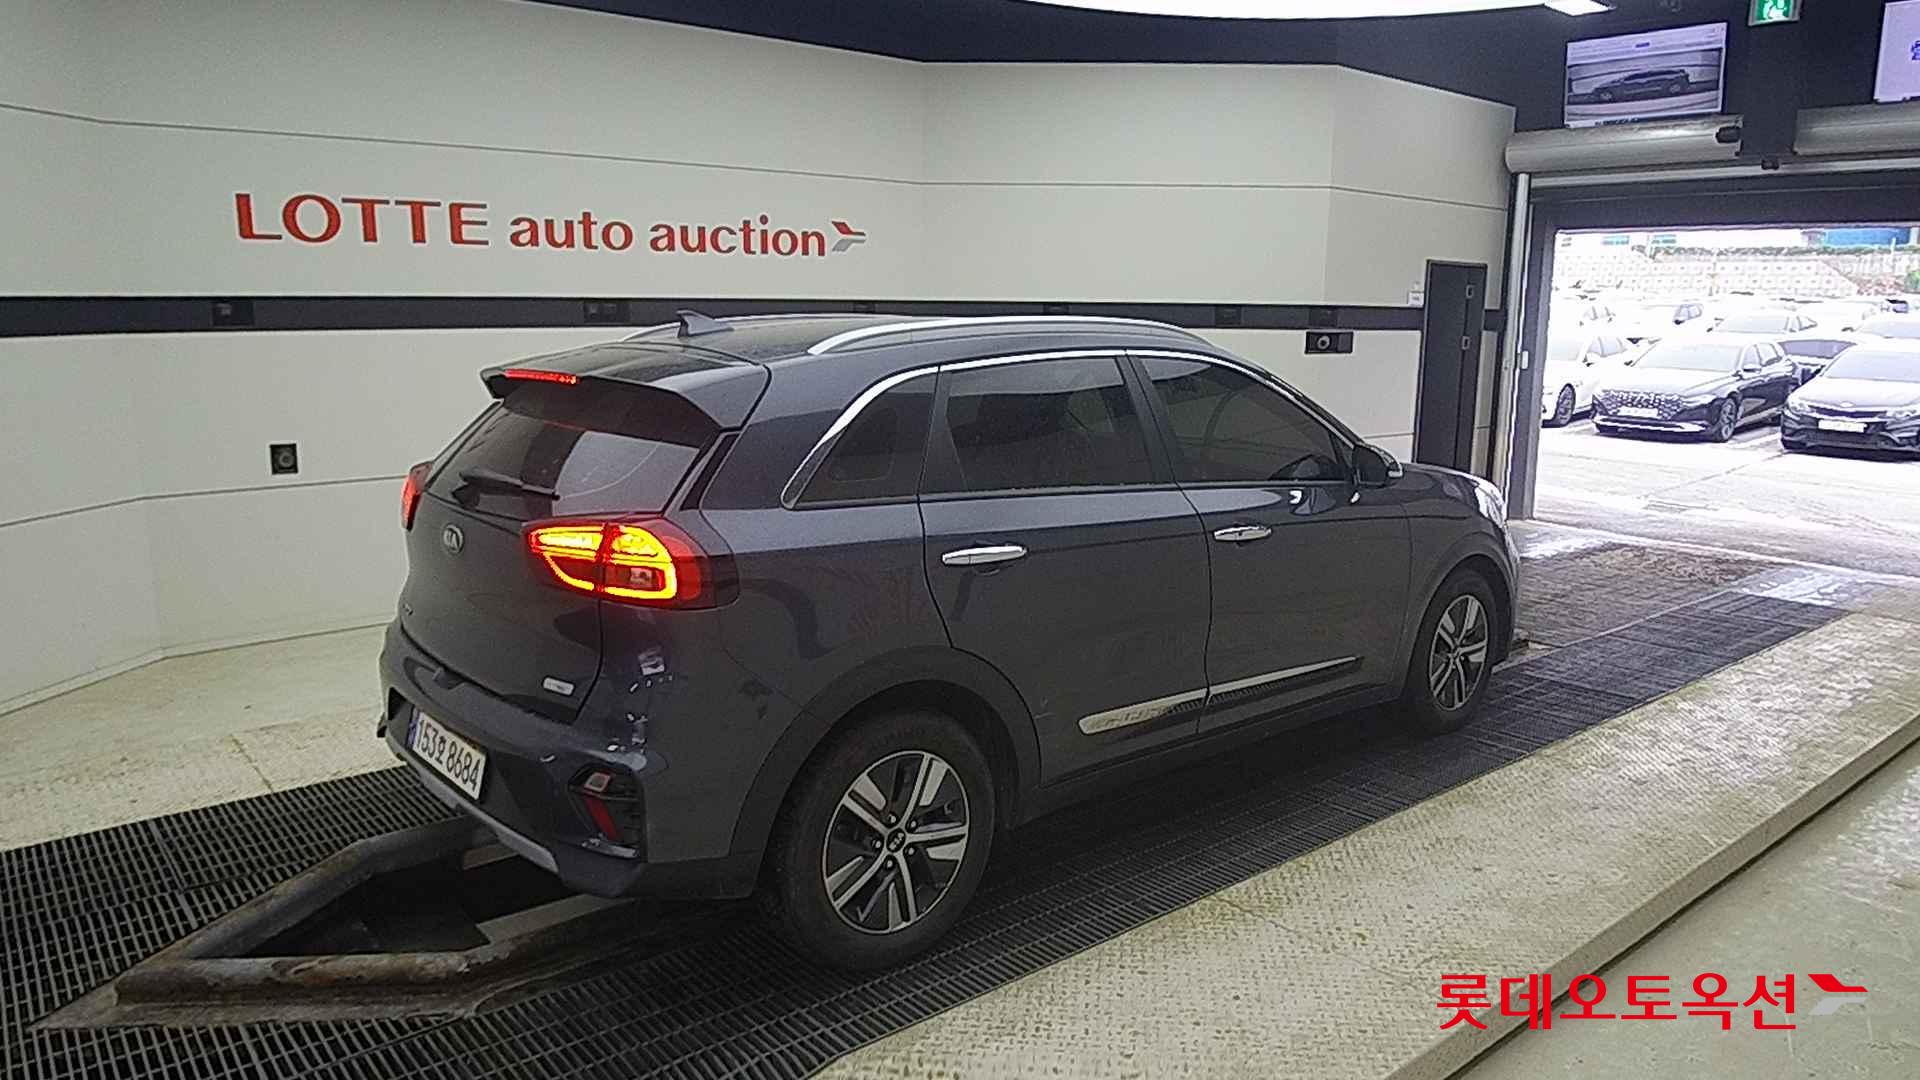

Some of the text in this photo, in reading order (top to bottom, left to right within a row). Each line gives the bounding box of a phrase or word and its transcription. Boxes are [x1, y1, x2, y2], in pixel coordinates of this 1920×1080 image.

[234, 192, 826, 256] LOTTE auto auction
